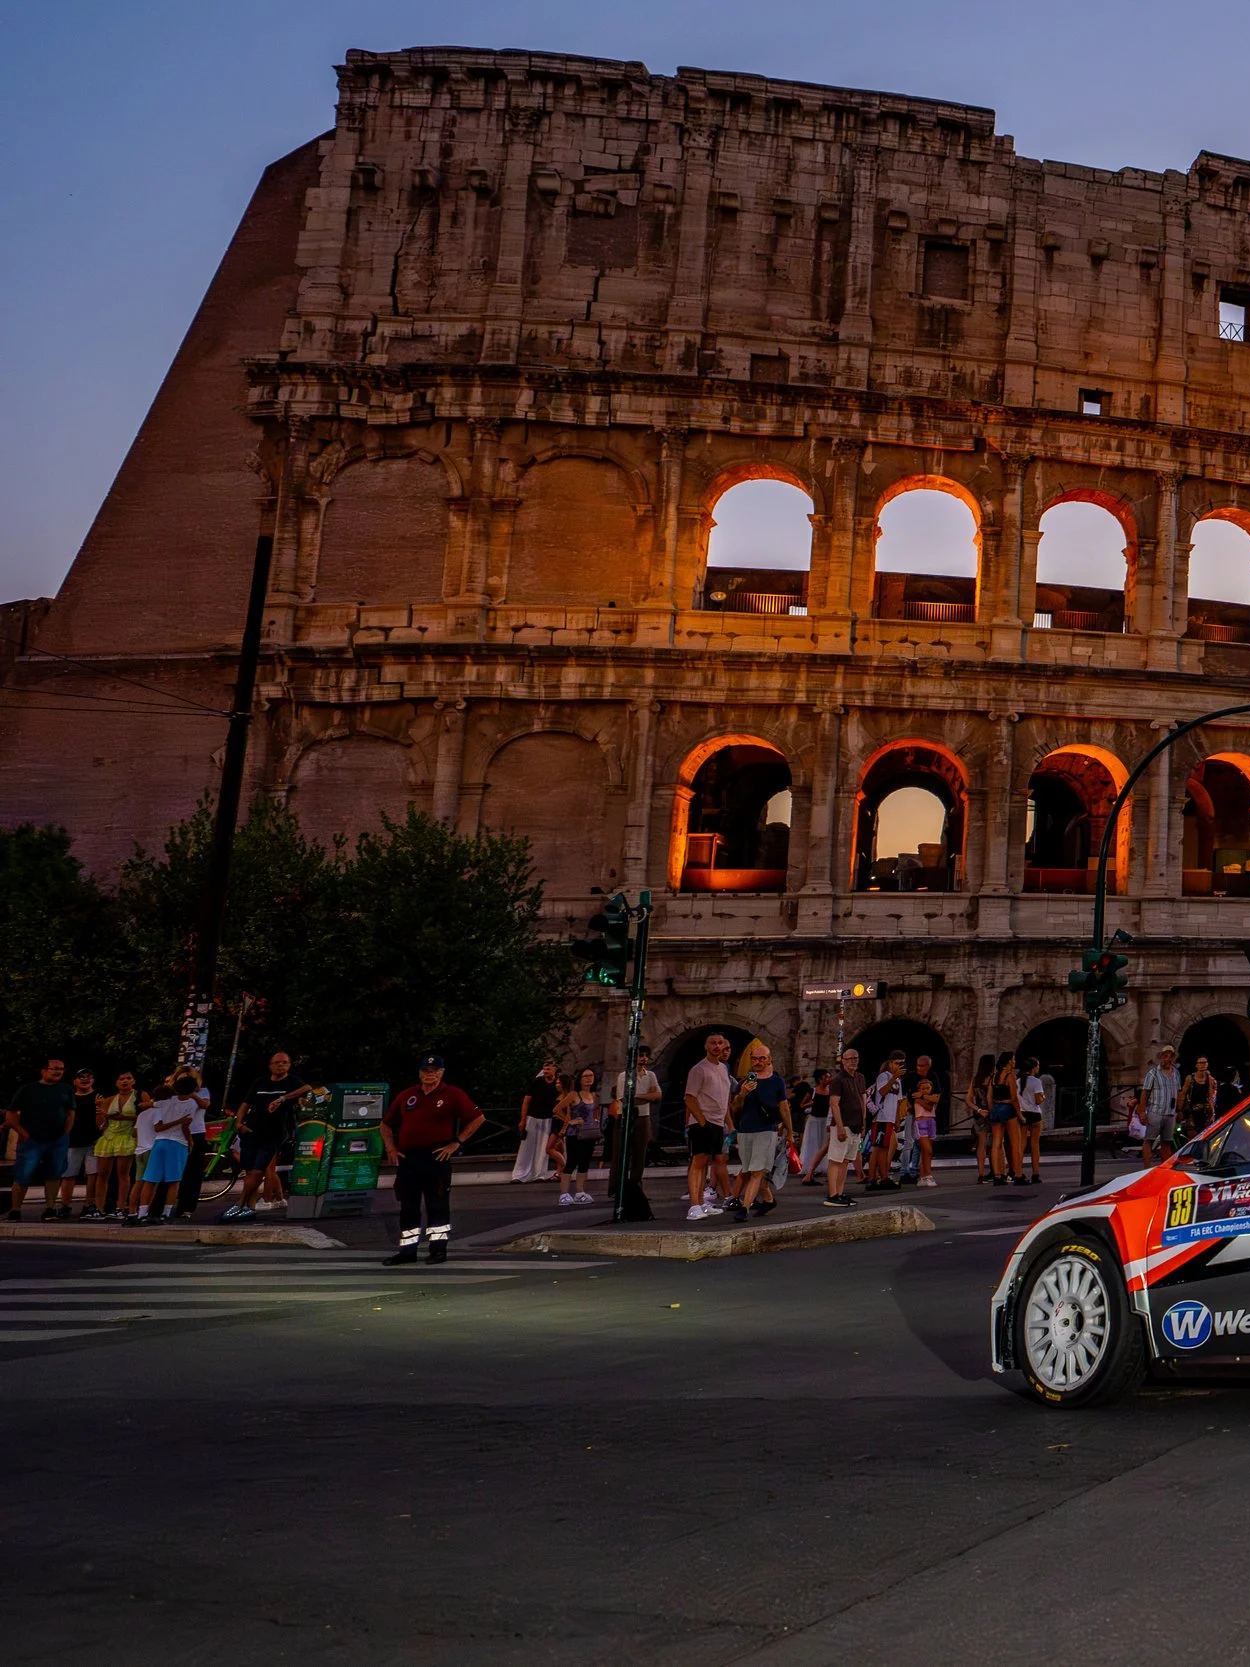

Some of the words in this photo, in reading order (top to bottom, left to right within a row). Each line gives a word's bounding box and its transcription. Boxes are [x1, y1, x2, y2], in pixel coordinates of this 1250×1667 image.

[1170, 1187, 1193, 1226] 33
[1190, 1227, 1200, 1237] FIA
[1202, 1226, 1214, 1235] ERC
